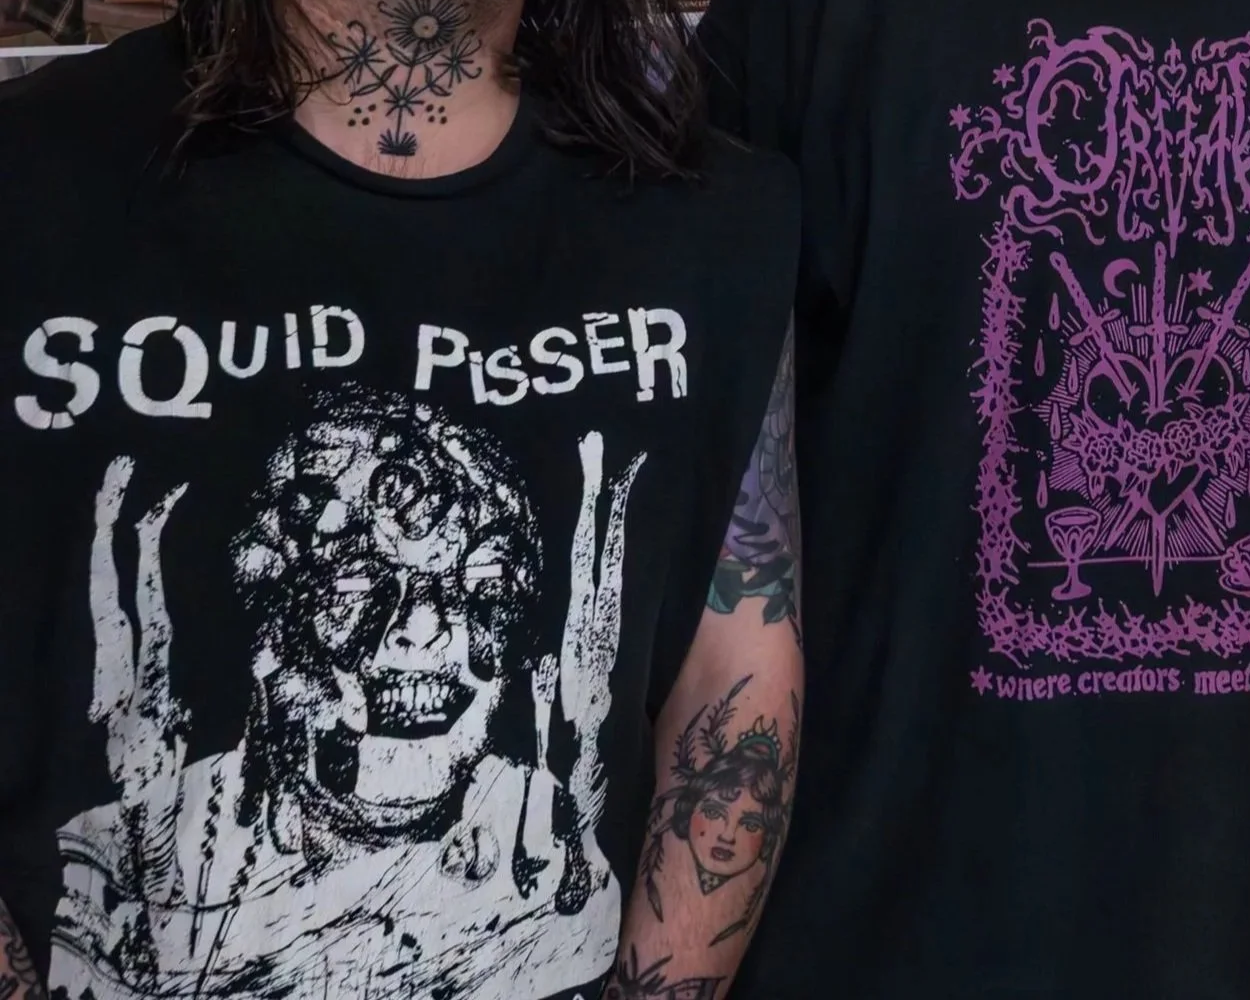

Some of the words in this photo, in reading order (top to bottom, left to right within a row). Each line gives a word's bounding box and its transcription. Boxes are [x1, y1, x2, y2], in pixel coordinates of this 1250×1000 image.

[14, 305, 366, 429] SQUID
[996, 670, 1072, 701] where
[1078, 666, 1179, 695] creators
